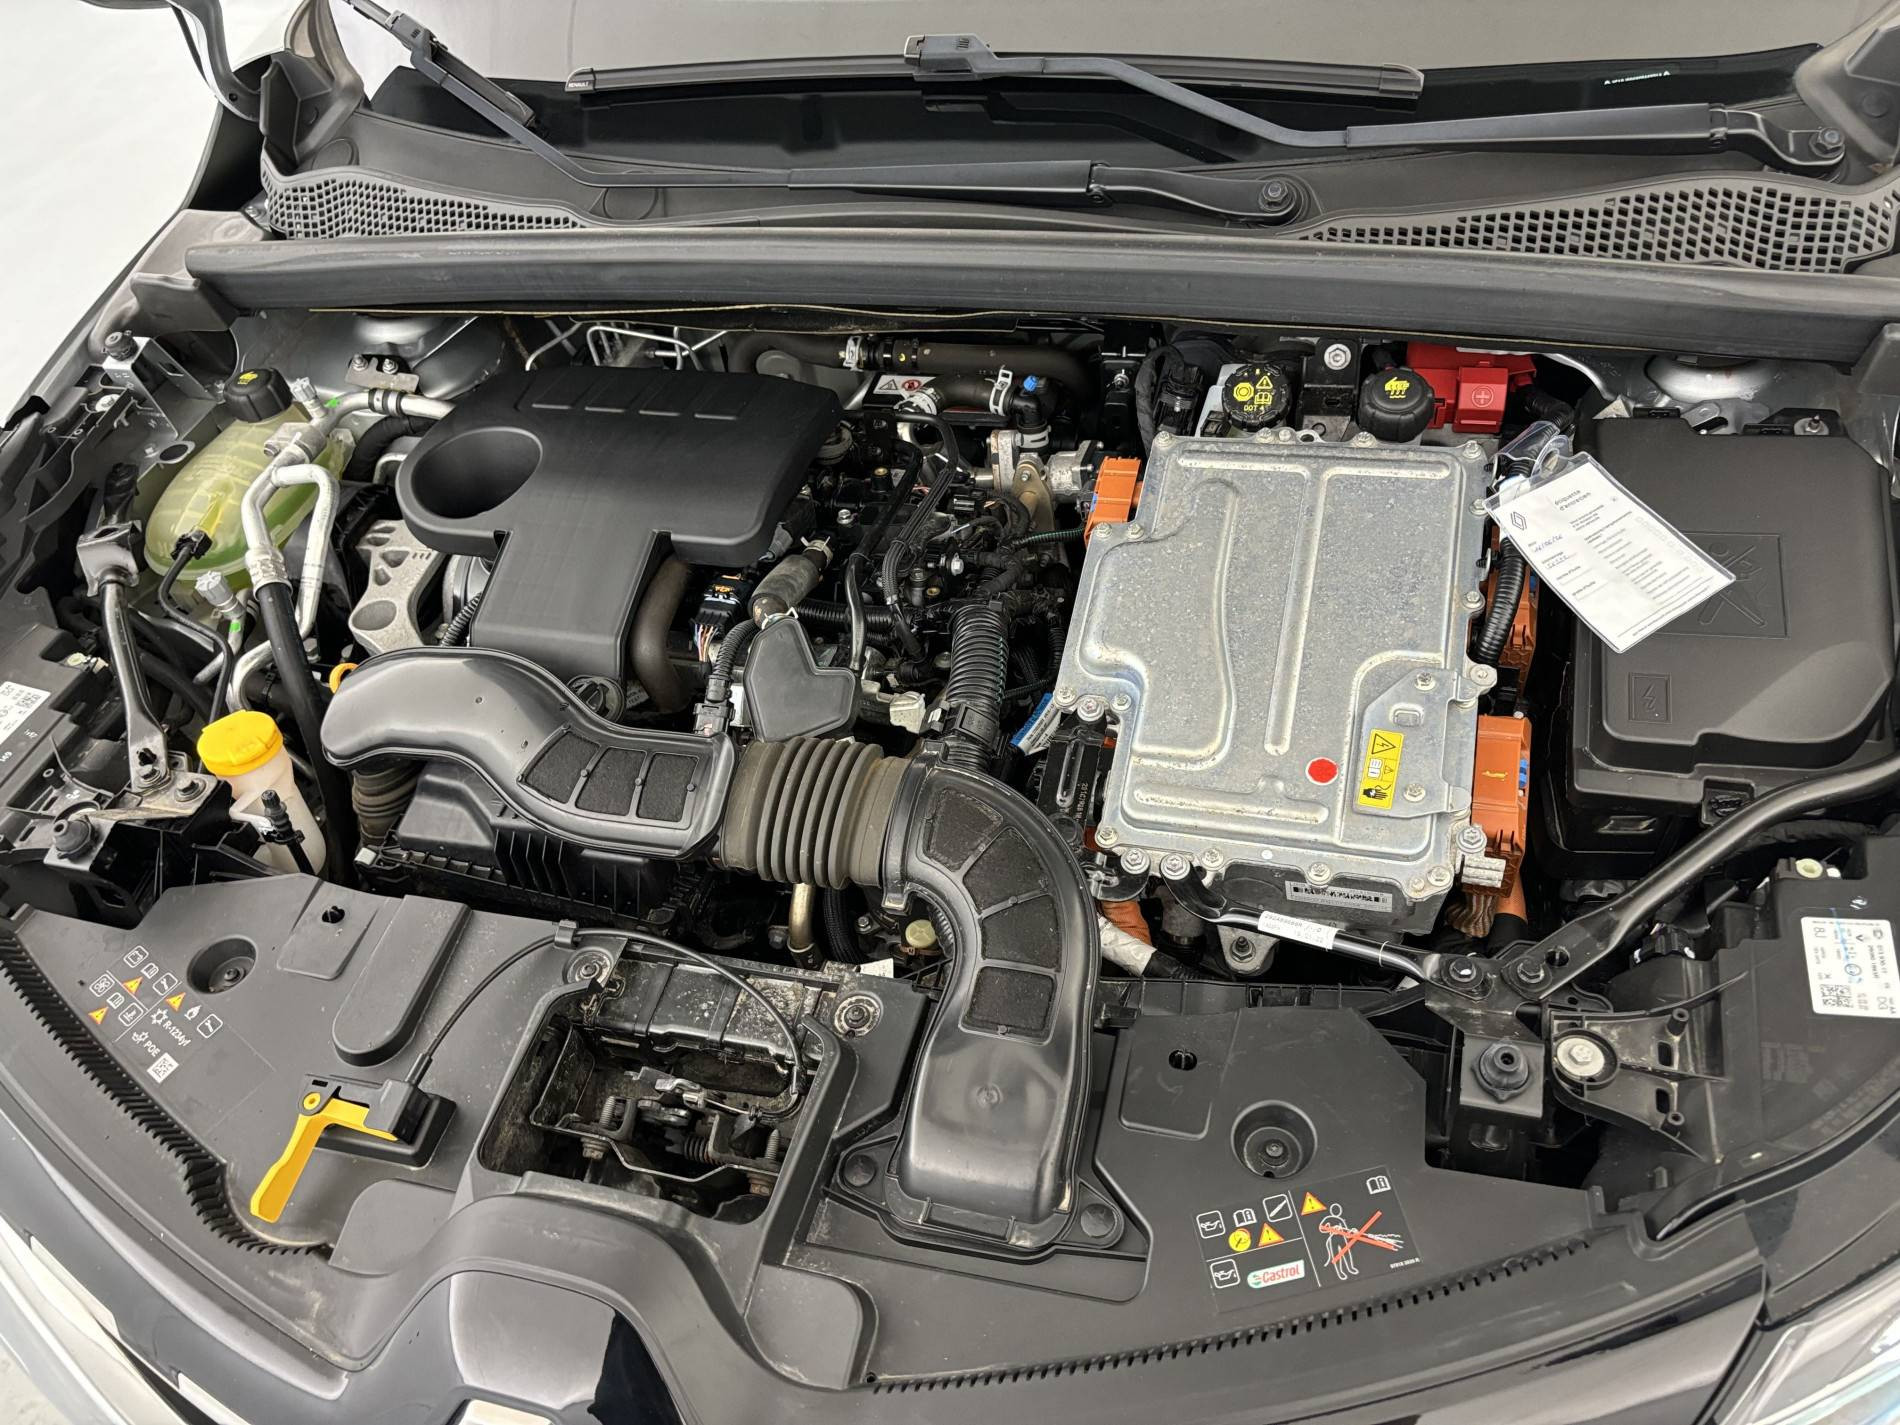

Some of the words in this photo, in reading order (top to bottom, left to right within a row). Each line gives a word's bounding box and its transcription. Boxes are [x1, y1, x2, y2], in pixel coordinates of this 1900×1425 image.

[162, 1019, 192, 1047] R-1234yf
[144, 1040, 161, 1057] POE
[1261, 1264, 1301, 1284] Castrol
